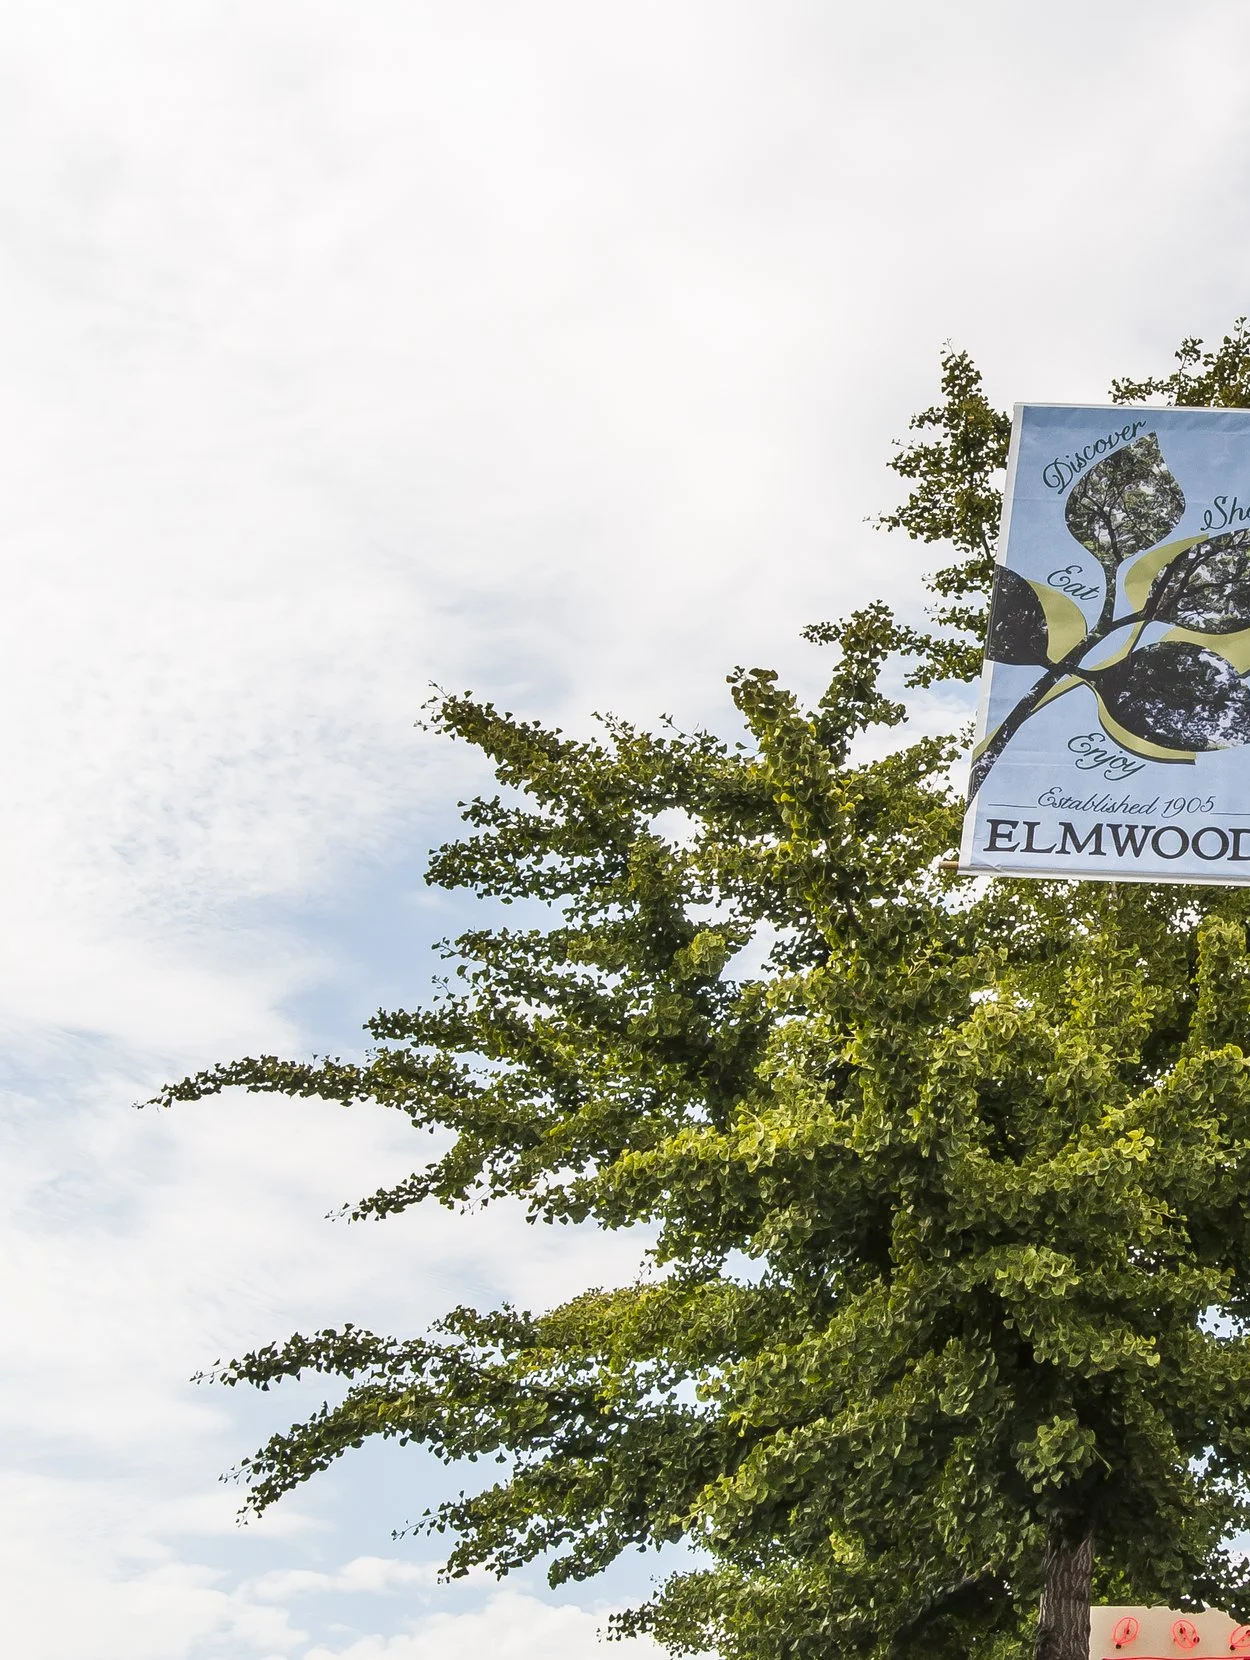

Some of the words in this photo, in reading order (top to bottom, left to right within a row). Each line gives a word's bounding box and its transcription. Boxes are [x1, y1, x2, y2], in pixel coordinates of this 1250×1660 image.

[1042, 419, 1147, 494] Discover
[1047, 564, 1098, 600] Eat
[1067, 732, 1145, 781] Enjoy
[1037, 787, 1159, 815] Established
[1161, 795, 1216, 818] 1905
